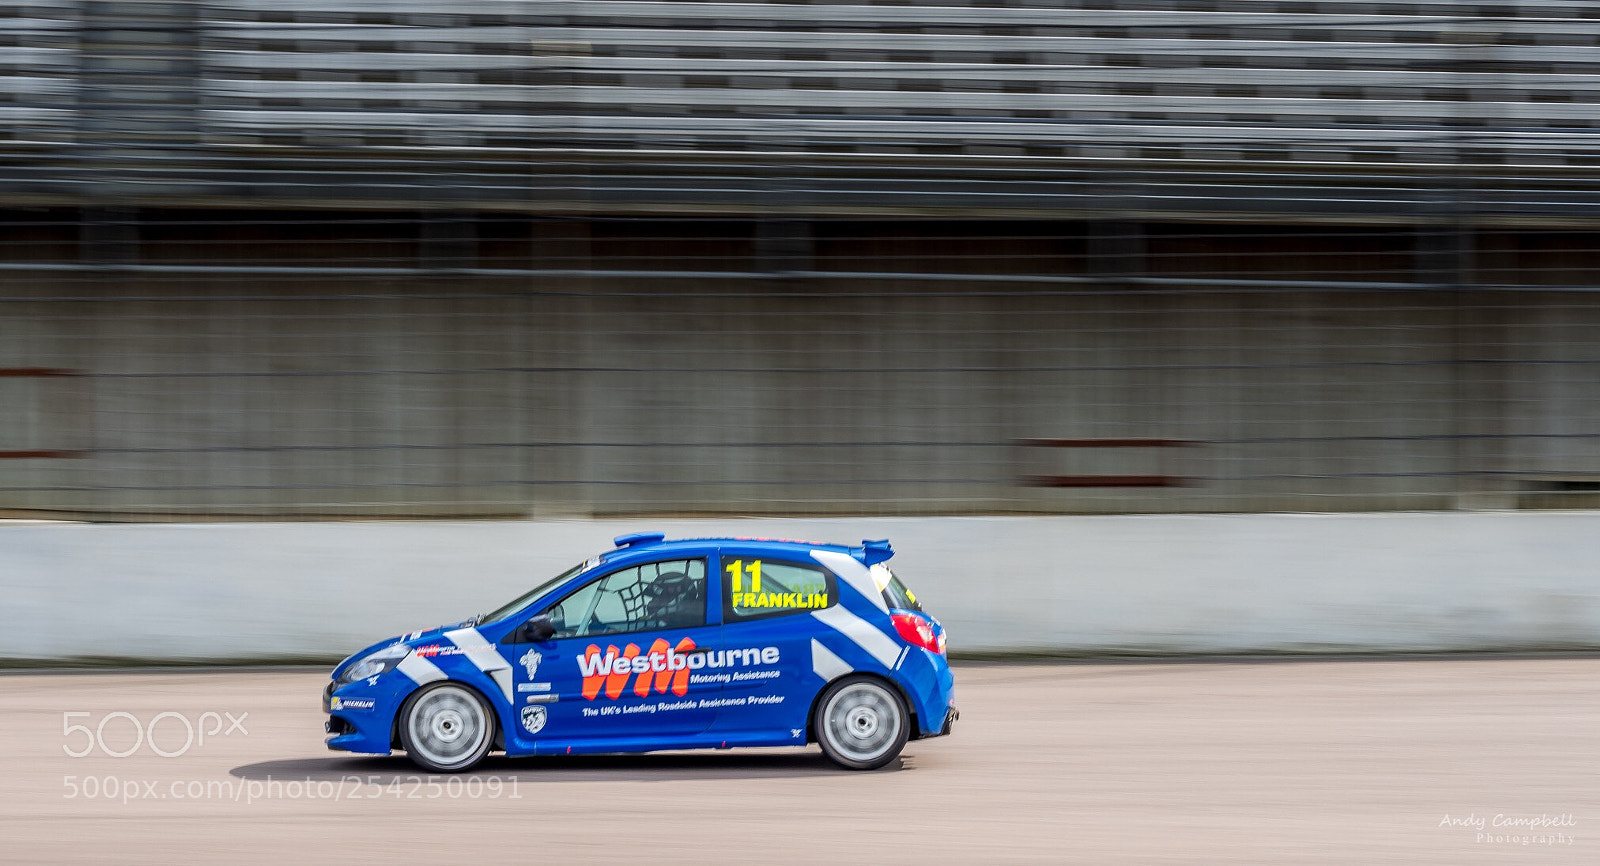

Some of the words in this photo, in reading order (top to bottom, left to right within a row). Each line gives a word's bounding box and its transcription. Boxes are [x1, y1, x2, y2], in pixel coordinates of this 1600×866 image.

[725, 559, 762, 593] 11
[732, 592, 828, 608] FRANKLIN
[576, 646, 780, 678] Westbourne
[690, 672, 731, 684] Motoring
[732, 670, 781, 681] Assistance
[582, 708, 599, 717] The
[600, 706, 621, 716] UK's
[622, 703, 656, 714] Leading
[658, 699, 697, 711] Roadside
[698, 696, 746, 708] Assistance
[747, 694, 785, 705] Provider
